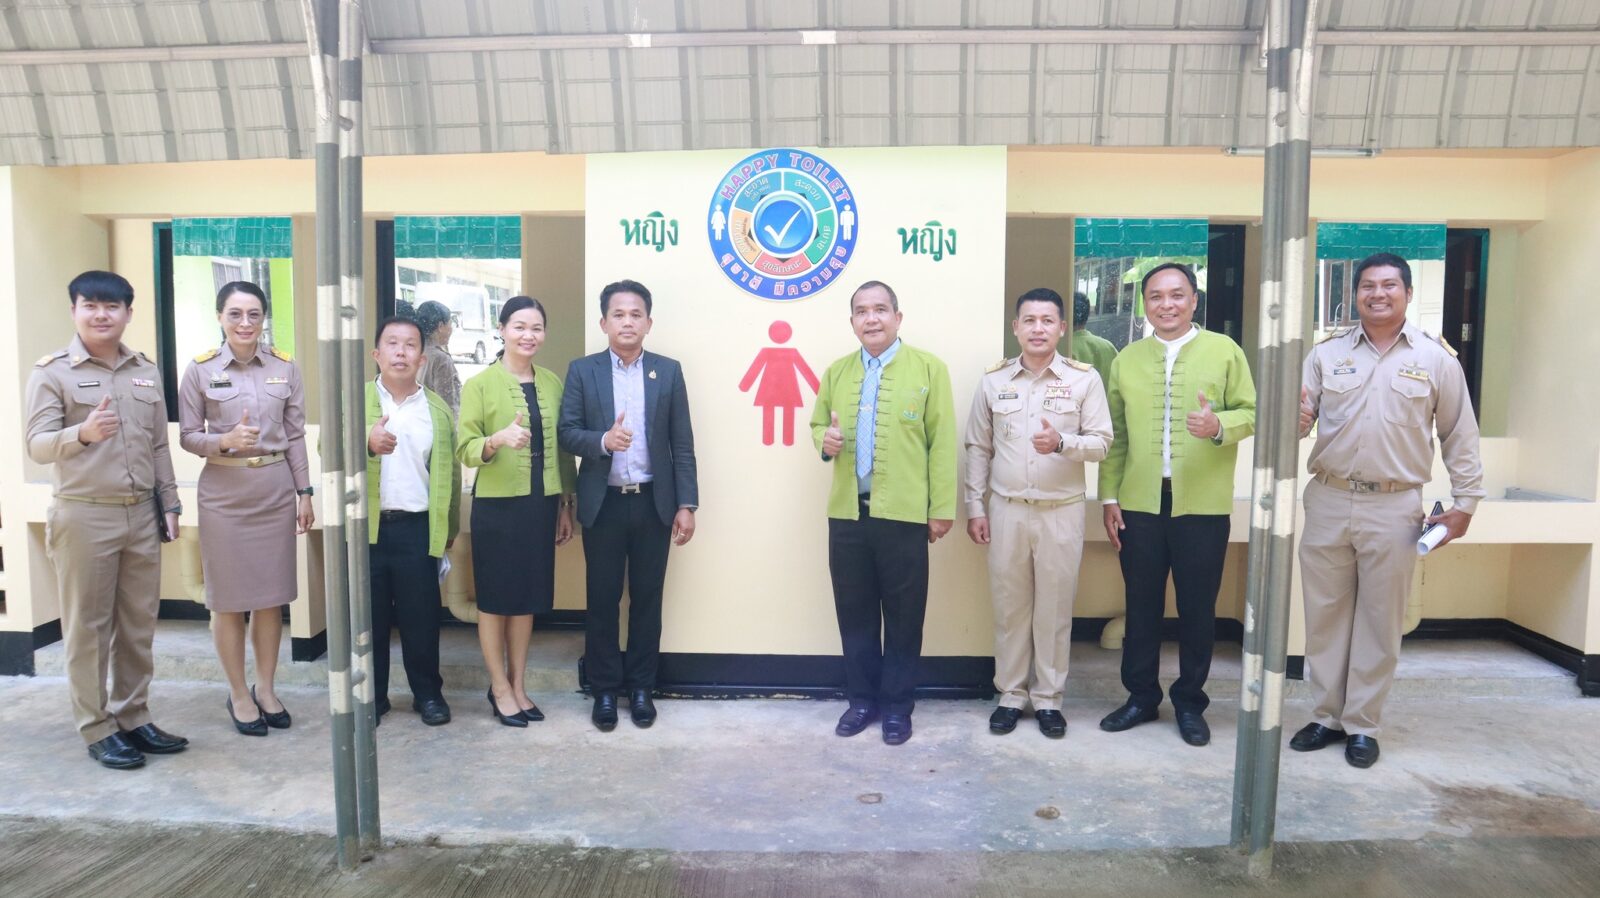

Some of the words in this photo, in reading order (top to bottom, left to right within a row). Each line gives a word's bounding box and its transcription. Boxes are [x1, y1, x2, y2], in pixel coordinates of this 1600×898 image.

[720, 153, 779, 201] HAPPY
[790, 152, 851, 202] TOILET
[620, 210, 679, 252] หญิง
[897, 220, 957, 262] หญิง
[773, 246, 847, 296] มีความสุข
